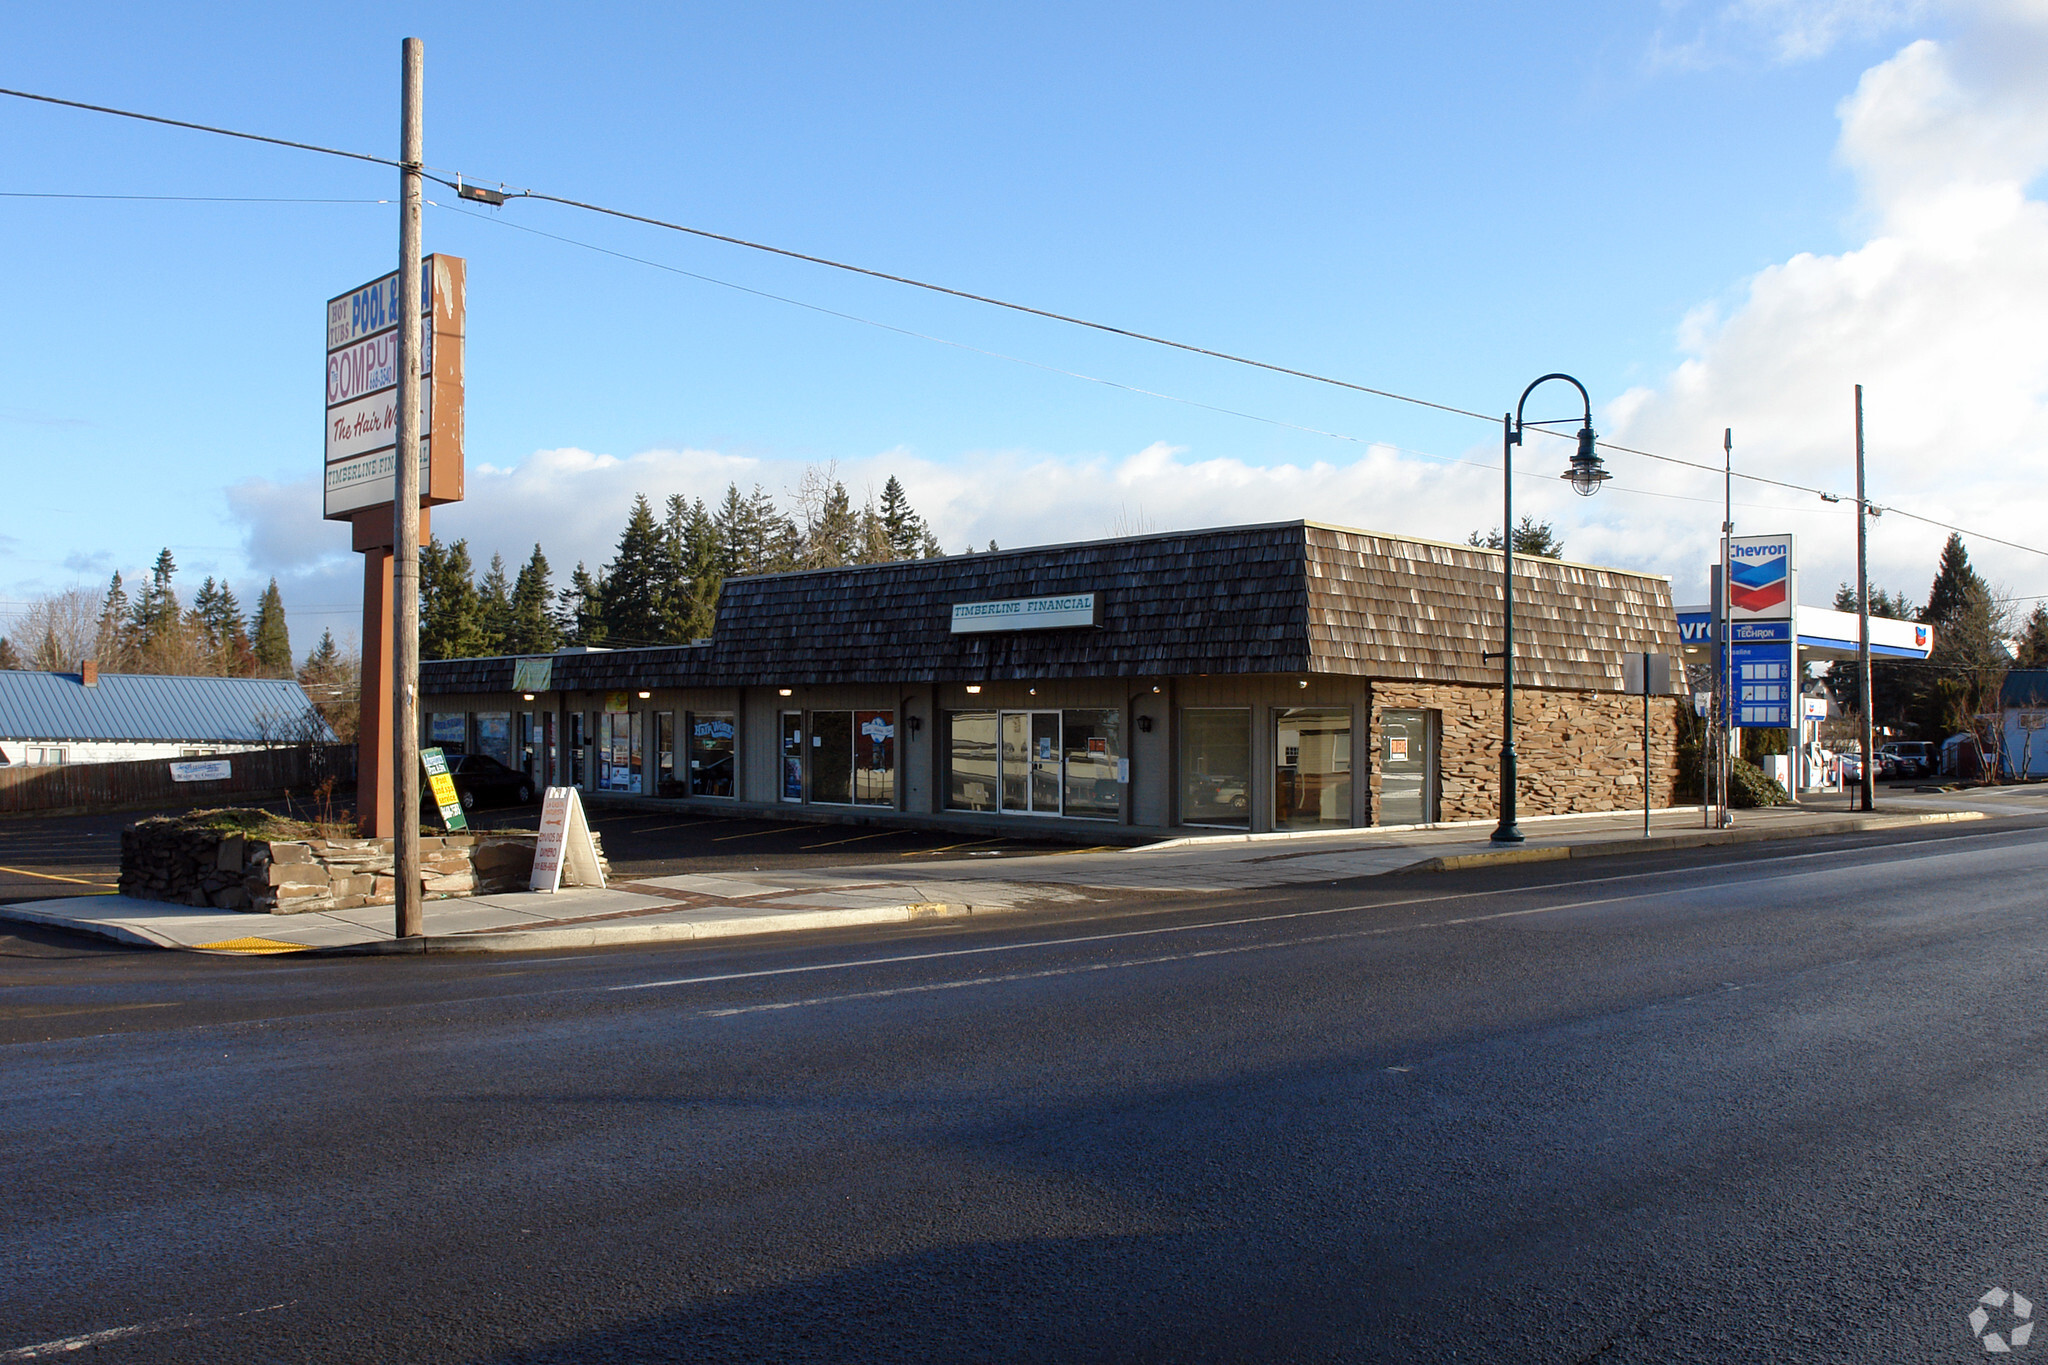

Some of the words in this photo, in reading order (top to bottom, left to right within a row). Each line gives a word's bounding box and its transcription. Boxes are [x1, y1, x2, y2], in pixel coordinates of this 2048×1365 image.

[332, 301, 348, 324] HOT
[352, 283, 385, 337] POOL
[330, 321, 349, 346] TUBS
[334, 416, 352, 442] The
[354, 411, 382, 437] Hair
[328, 459, 377, 486] TIMBERLINE
[954, 602, 1021, 617] TIMBERLINE
[1027, 597, 1092, 612] FINANCIAL
[1737, 629, 1775, 639] TECHRON
